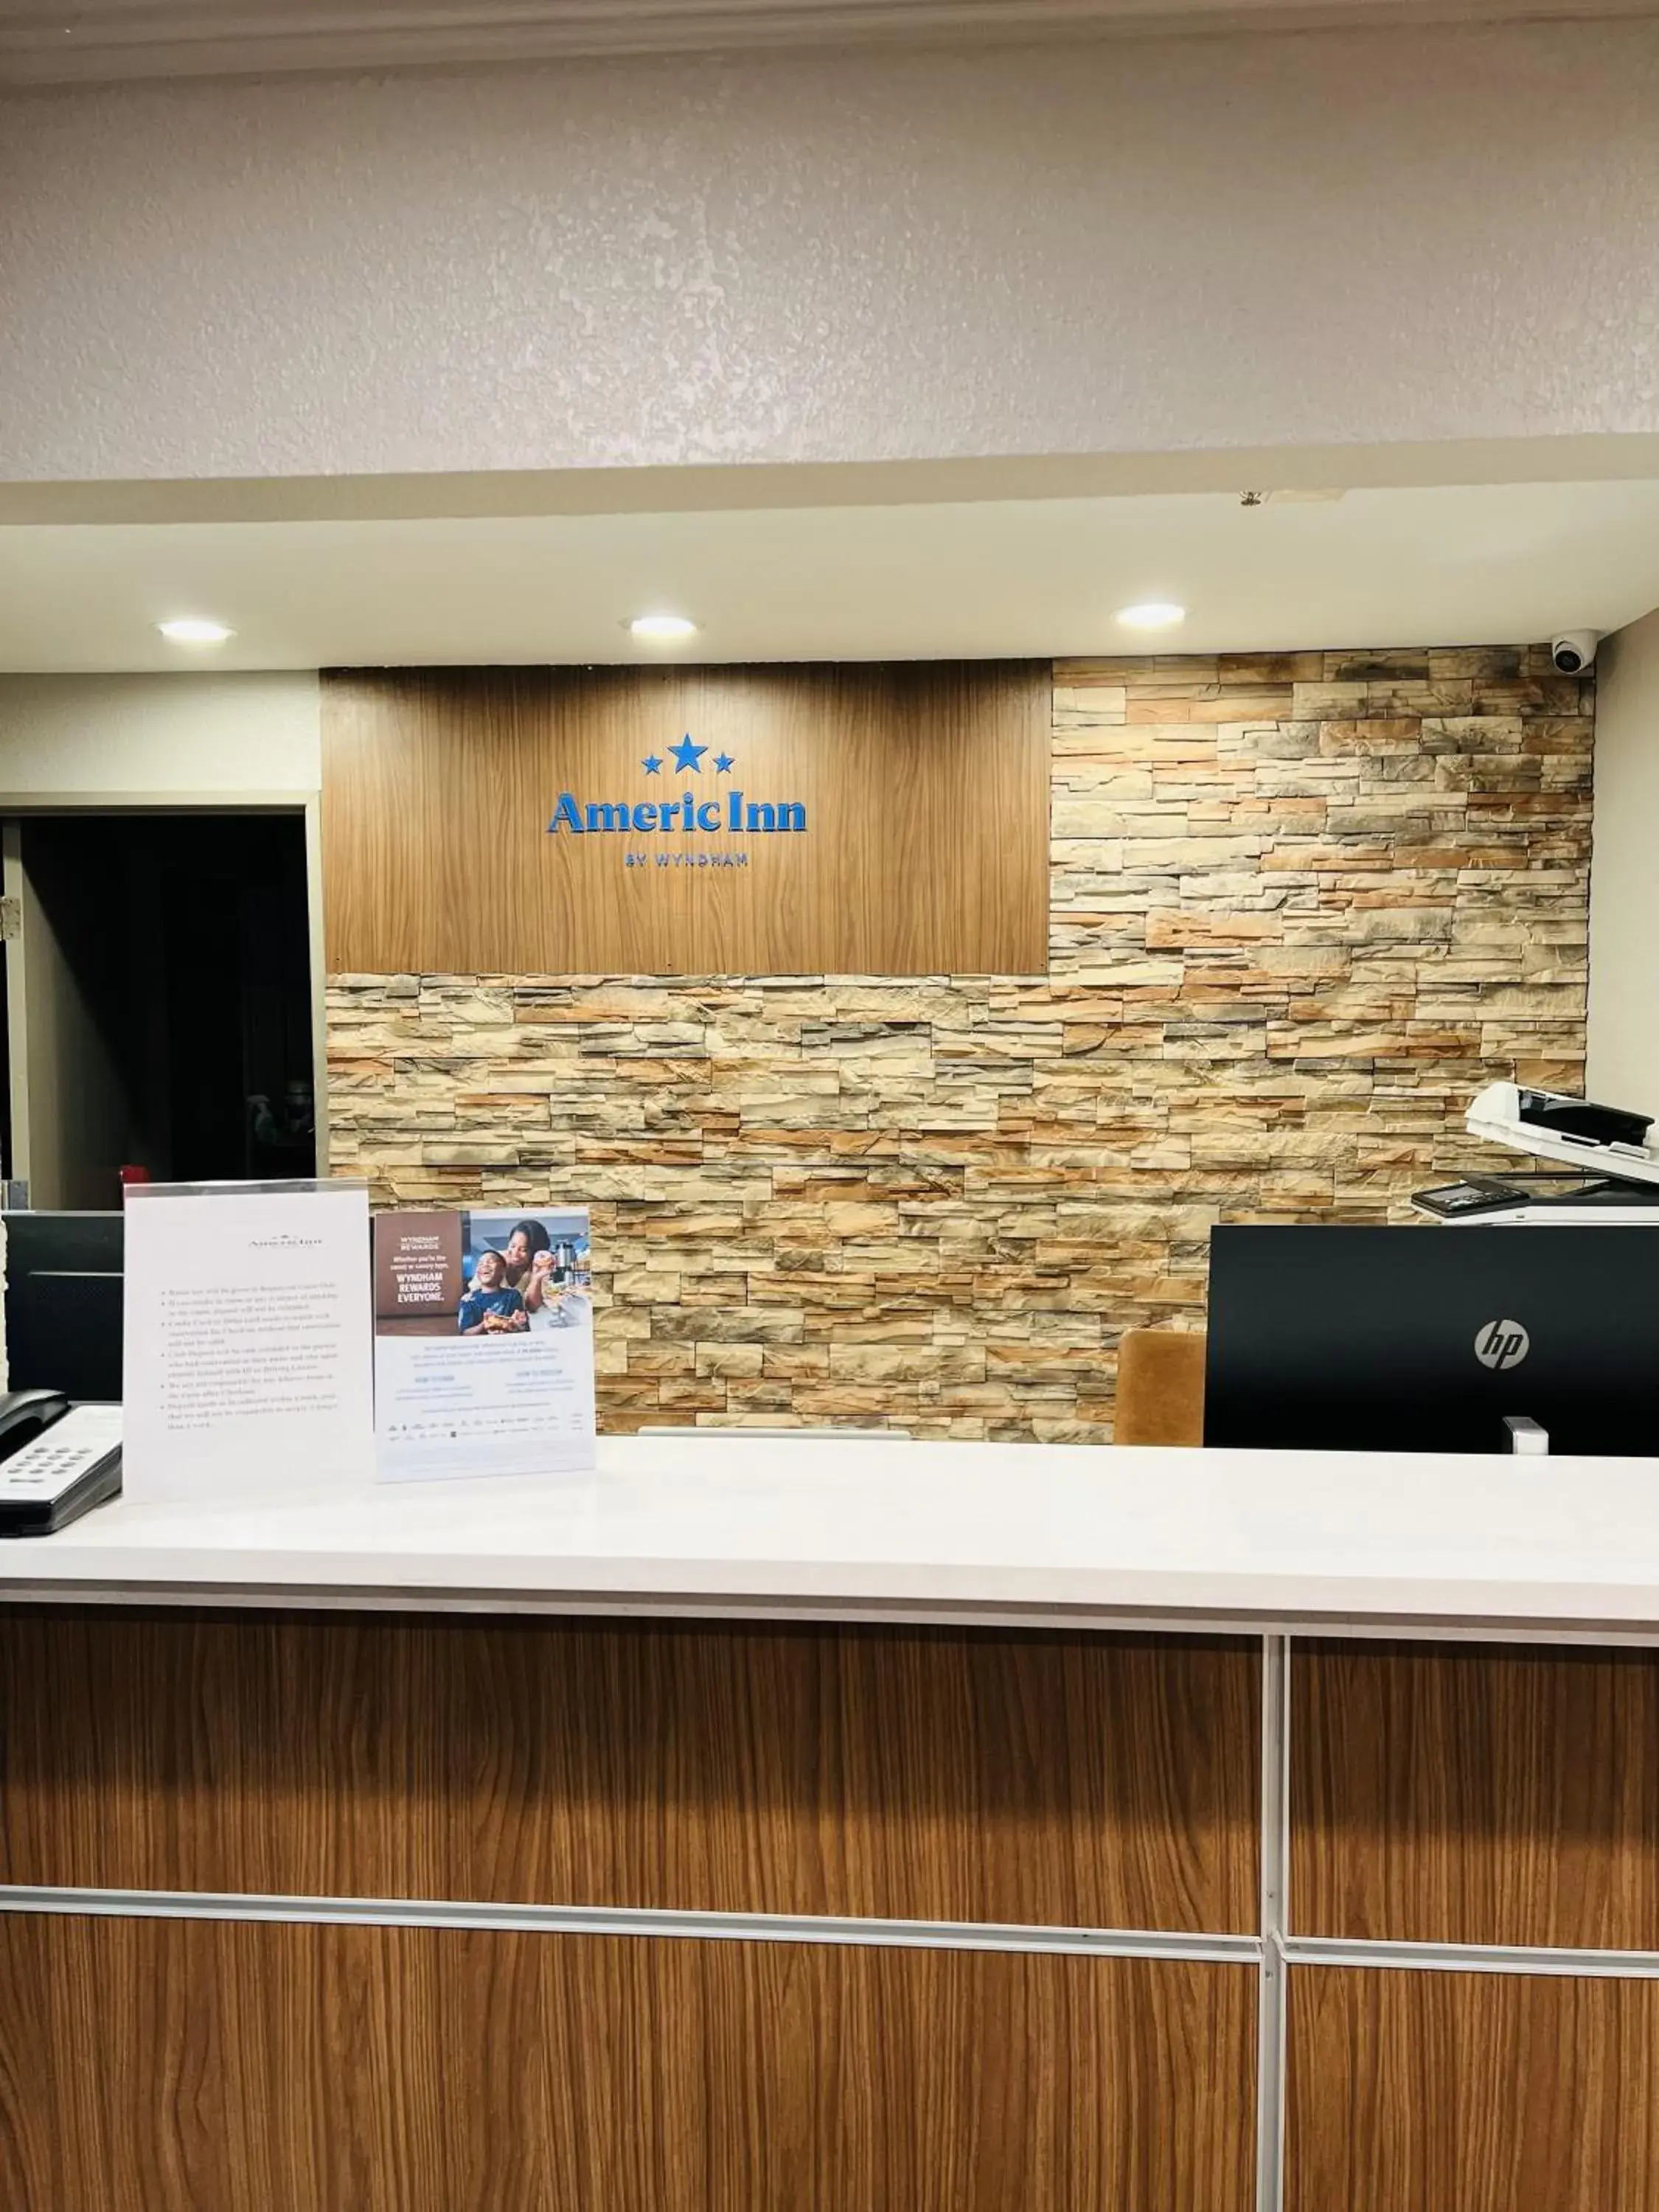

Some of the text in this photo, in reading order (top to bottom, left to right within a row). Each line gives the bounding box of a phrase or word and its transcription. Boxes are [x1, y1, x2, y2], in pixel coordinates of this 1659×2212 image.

[546, 790, 809, 834] AmericInn
[625, 852, 748, 867] BY WYNDHAM
[396, 1273, 442, 1282] WYNDHAM
[399, 1282, 441, 1292] REWARDS
[397, 1292, 445, 1303] EVERYONE.
[1480, 1319, 1524, 1369] hp
